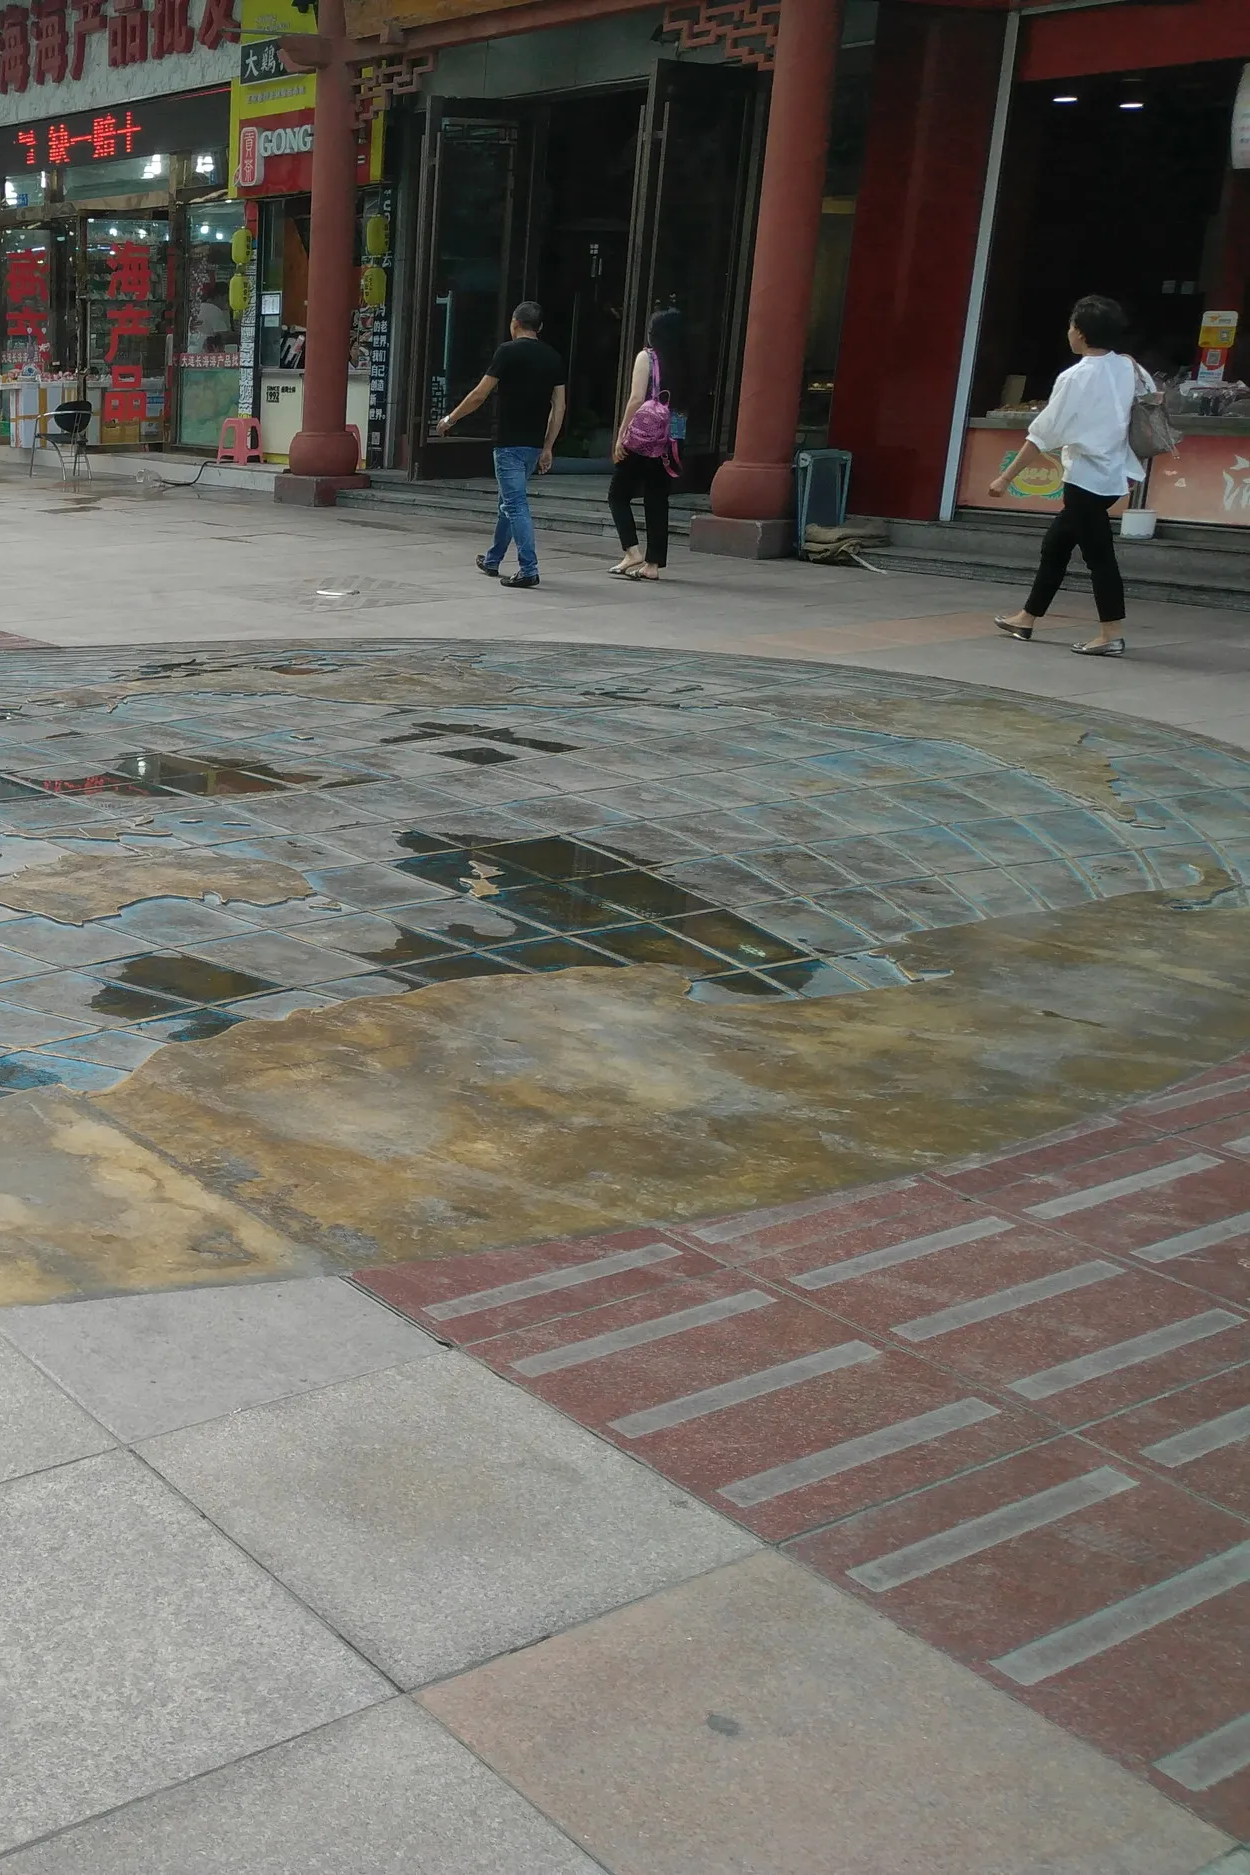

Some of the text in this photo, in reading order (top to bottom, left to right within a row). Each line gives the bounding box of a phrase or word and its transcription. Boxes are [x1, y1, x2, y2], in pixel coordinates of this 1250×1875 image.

[259, 124, 314, 157] GONG
[104, 241, 152, 422] 海产品
[371, 365, 384, 377] 自己
[266, 392, 280, 401] 1992
